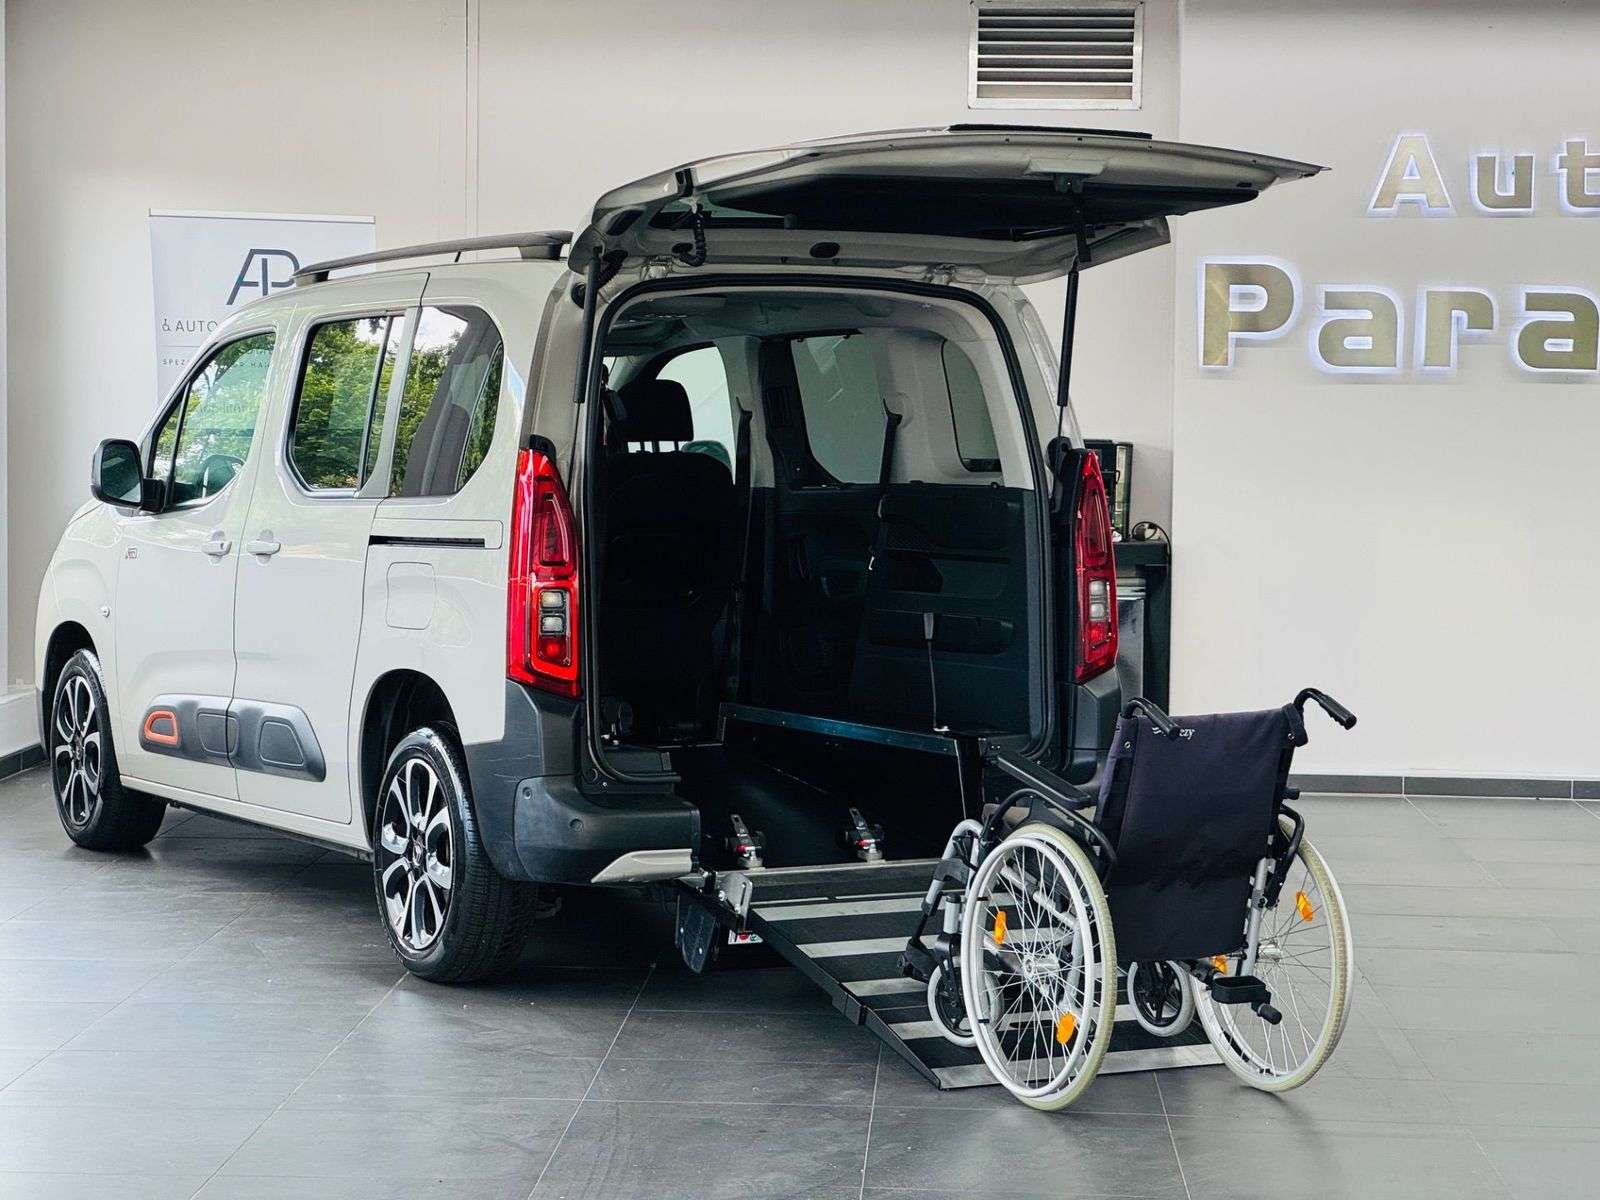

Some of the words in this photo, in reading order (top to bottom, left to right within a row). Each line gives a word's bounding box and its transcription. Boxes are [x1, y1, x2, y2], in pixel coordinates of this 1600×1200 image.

[1368, 134, 1600, 214] Aut
[175, 319, 218, 332] AUTO
[1201, 261, 1600, 371] Para
[161, 358, 190, 367] SPEZ
